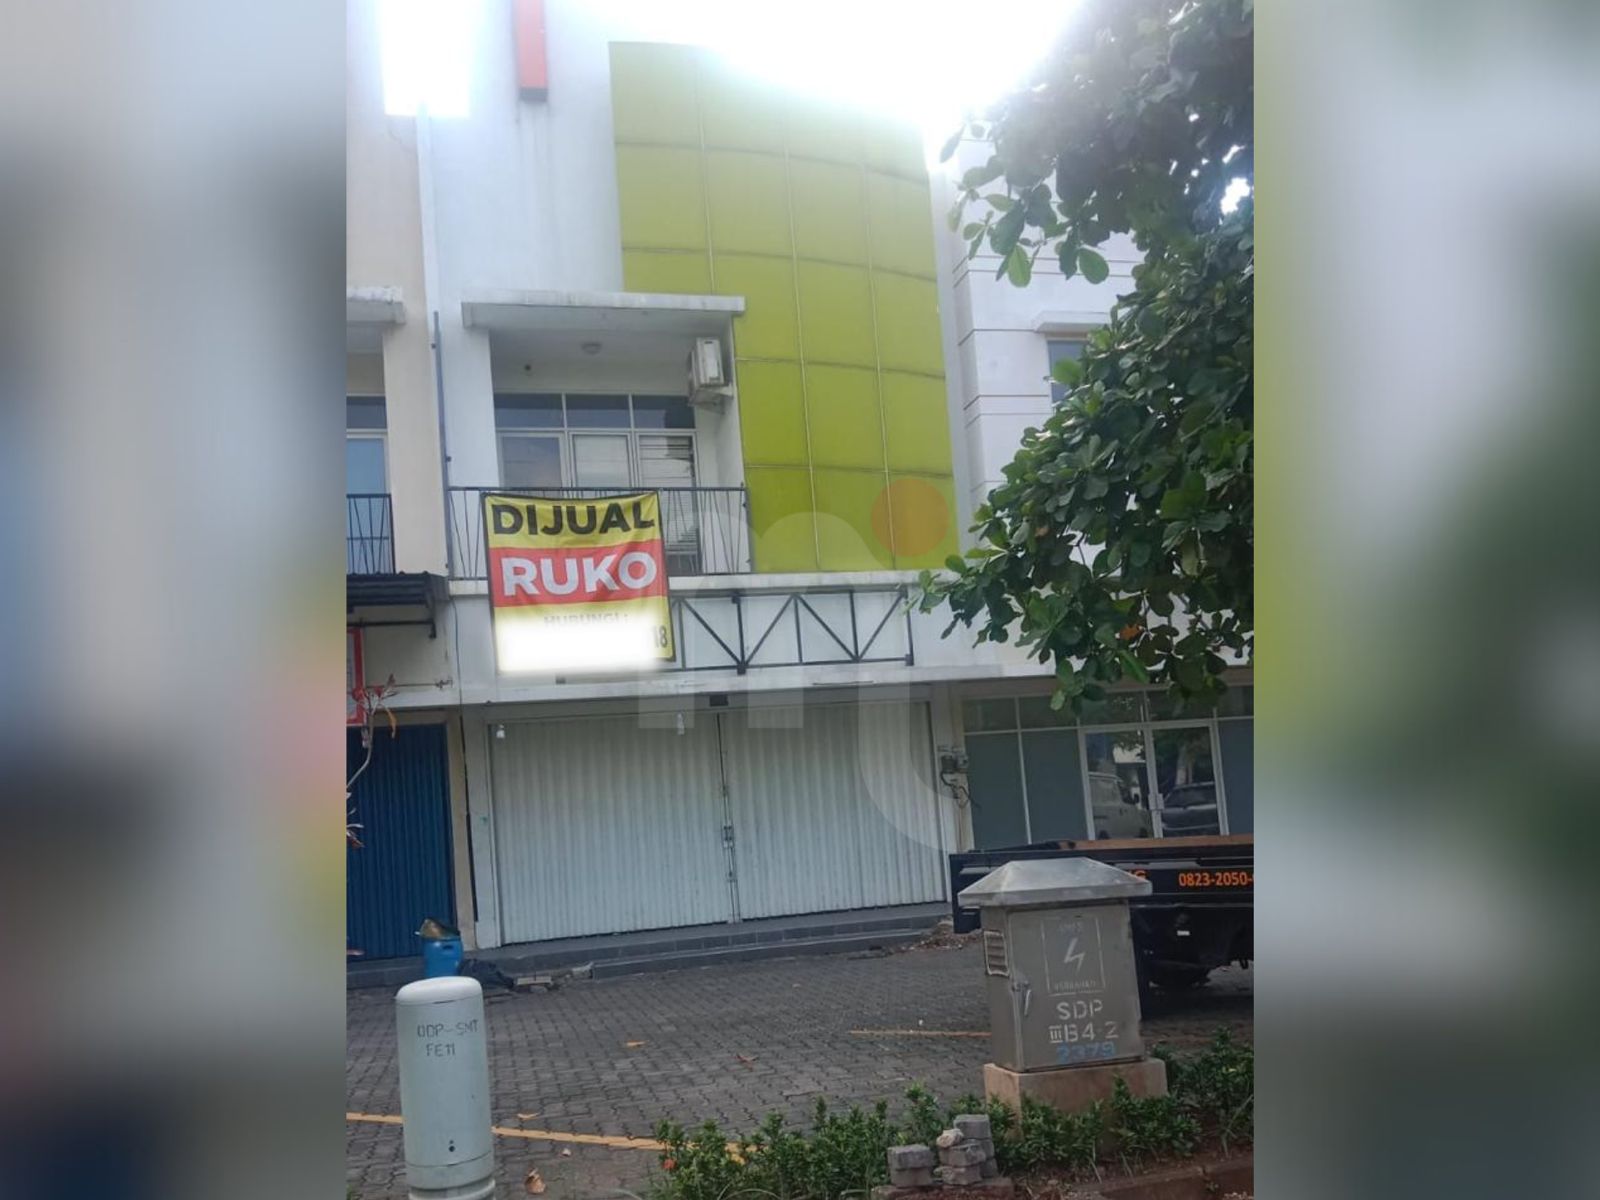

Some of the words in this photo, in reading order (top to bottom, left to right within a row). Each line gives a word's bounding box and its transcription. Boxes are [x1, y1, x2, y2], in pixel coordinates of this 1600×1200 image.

[492, 502, 655, 535] DIJUAL
[501, 552, 657, 596] RUKO
[1179, 871, 1254, 887] 0823-2050-
[1056, 999, 1103, 1020] SDP
